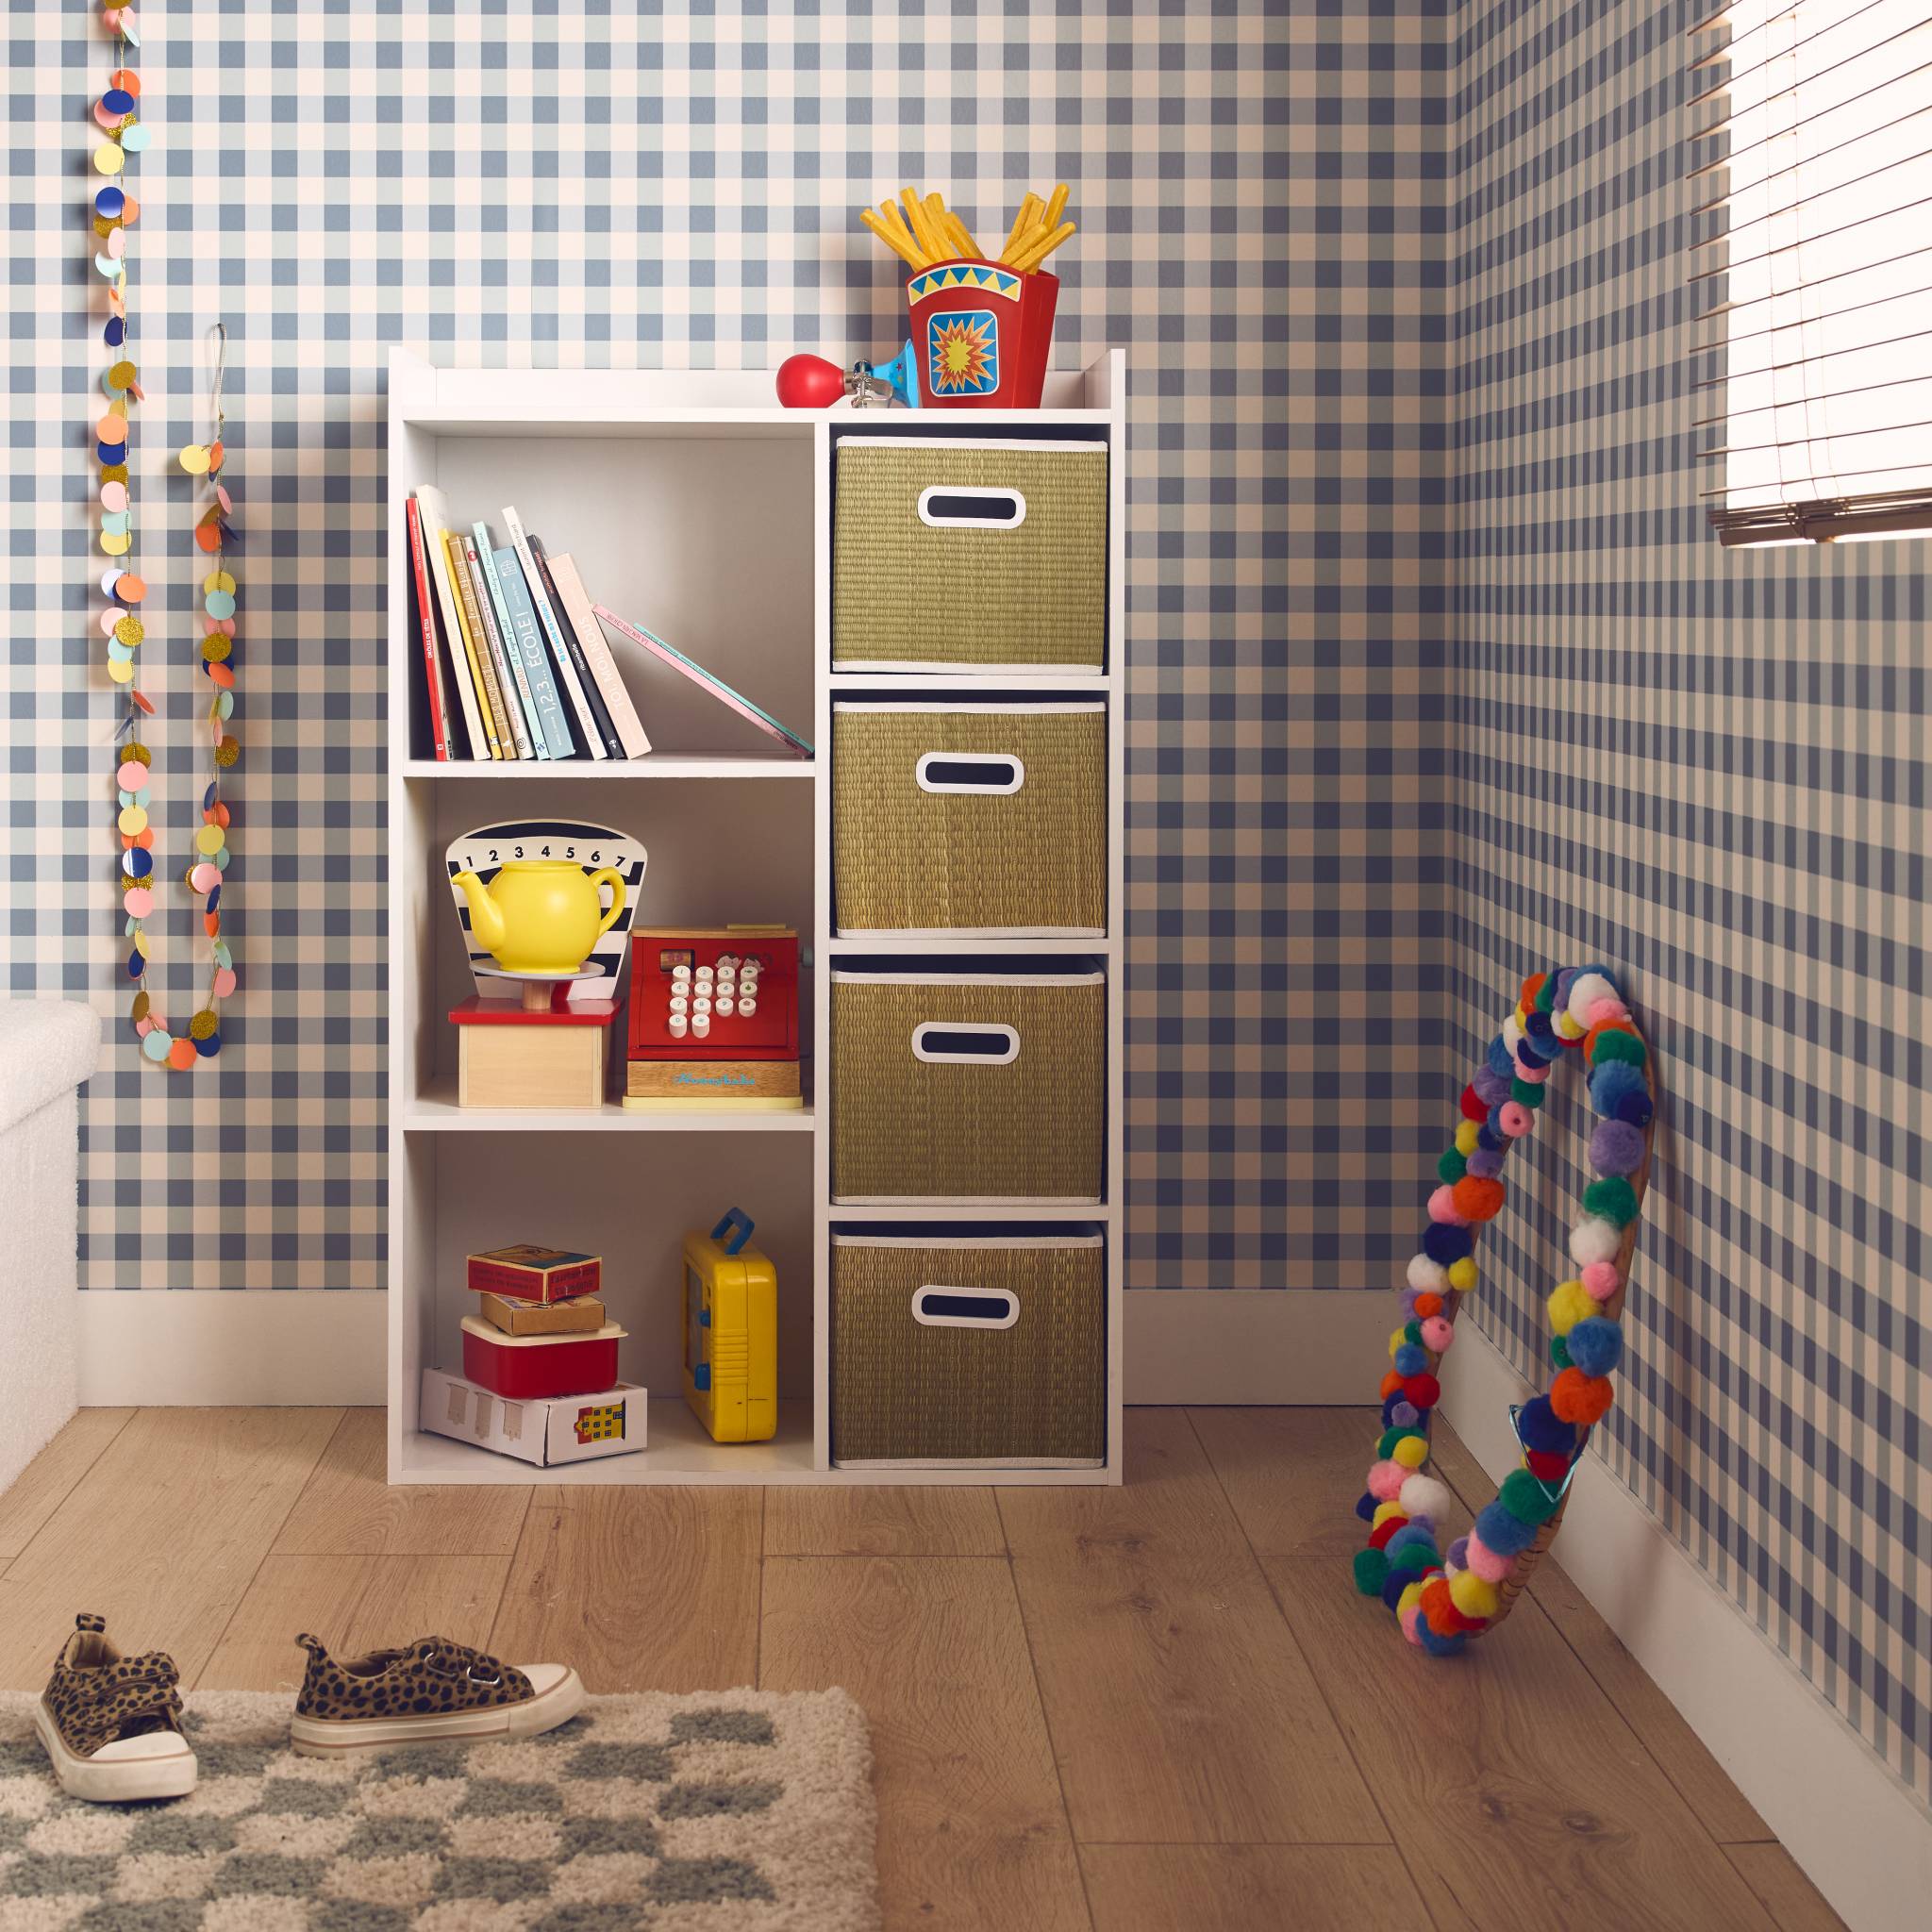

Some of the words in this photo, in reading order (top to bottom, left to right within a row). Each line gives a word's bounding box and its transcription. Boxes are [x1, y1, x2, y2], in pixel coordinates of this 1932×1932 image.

[517, 617, 542, 668] ÉCOLE
[576, 615, 601, 653] NOUS
[466, 857, 474, 867] 1
[489, 850, 498, 861] 2
[515, 846, 524, 858] 3
[541, 845, 550, 857] 4
[566, 847, 575, 858] 5
[591, 851, 601, 862] 6
[615, 856, 625, 868] 7
